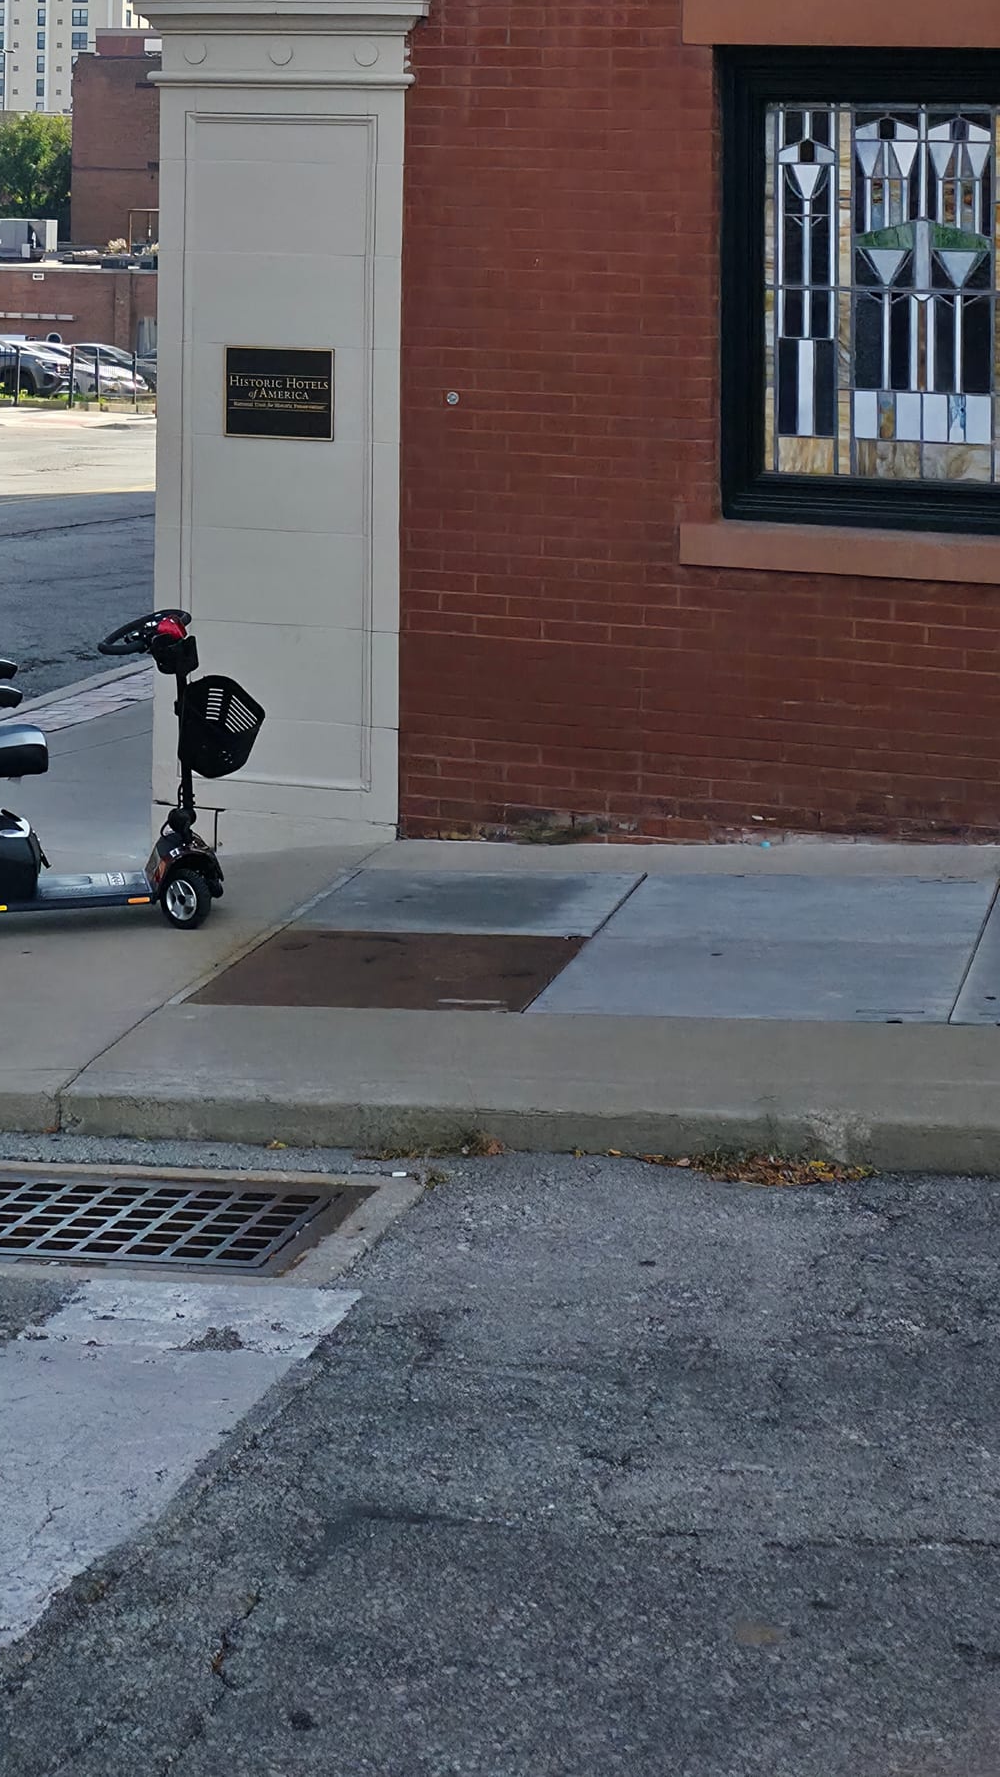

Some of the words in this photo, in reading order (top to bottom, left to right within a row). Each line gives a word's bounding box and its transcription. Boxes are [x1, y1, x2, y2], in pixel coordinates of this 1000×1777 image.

[229, 375, 283, 388] HISTORIC
[286, 377, 329, 390] HOTELS
[248, 389, 259, 400] of
[259, 387, 310, 400] AMERICA
